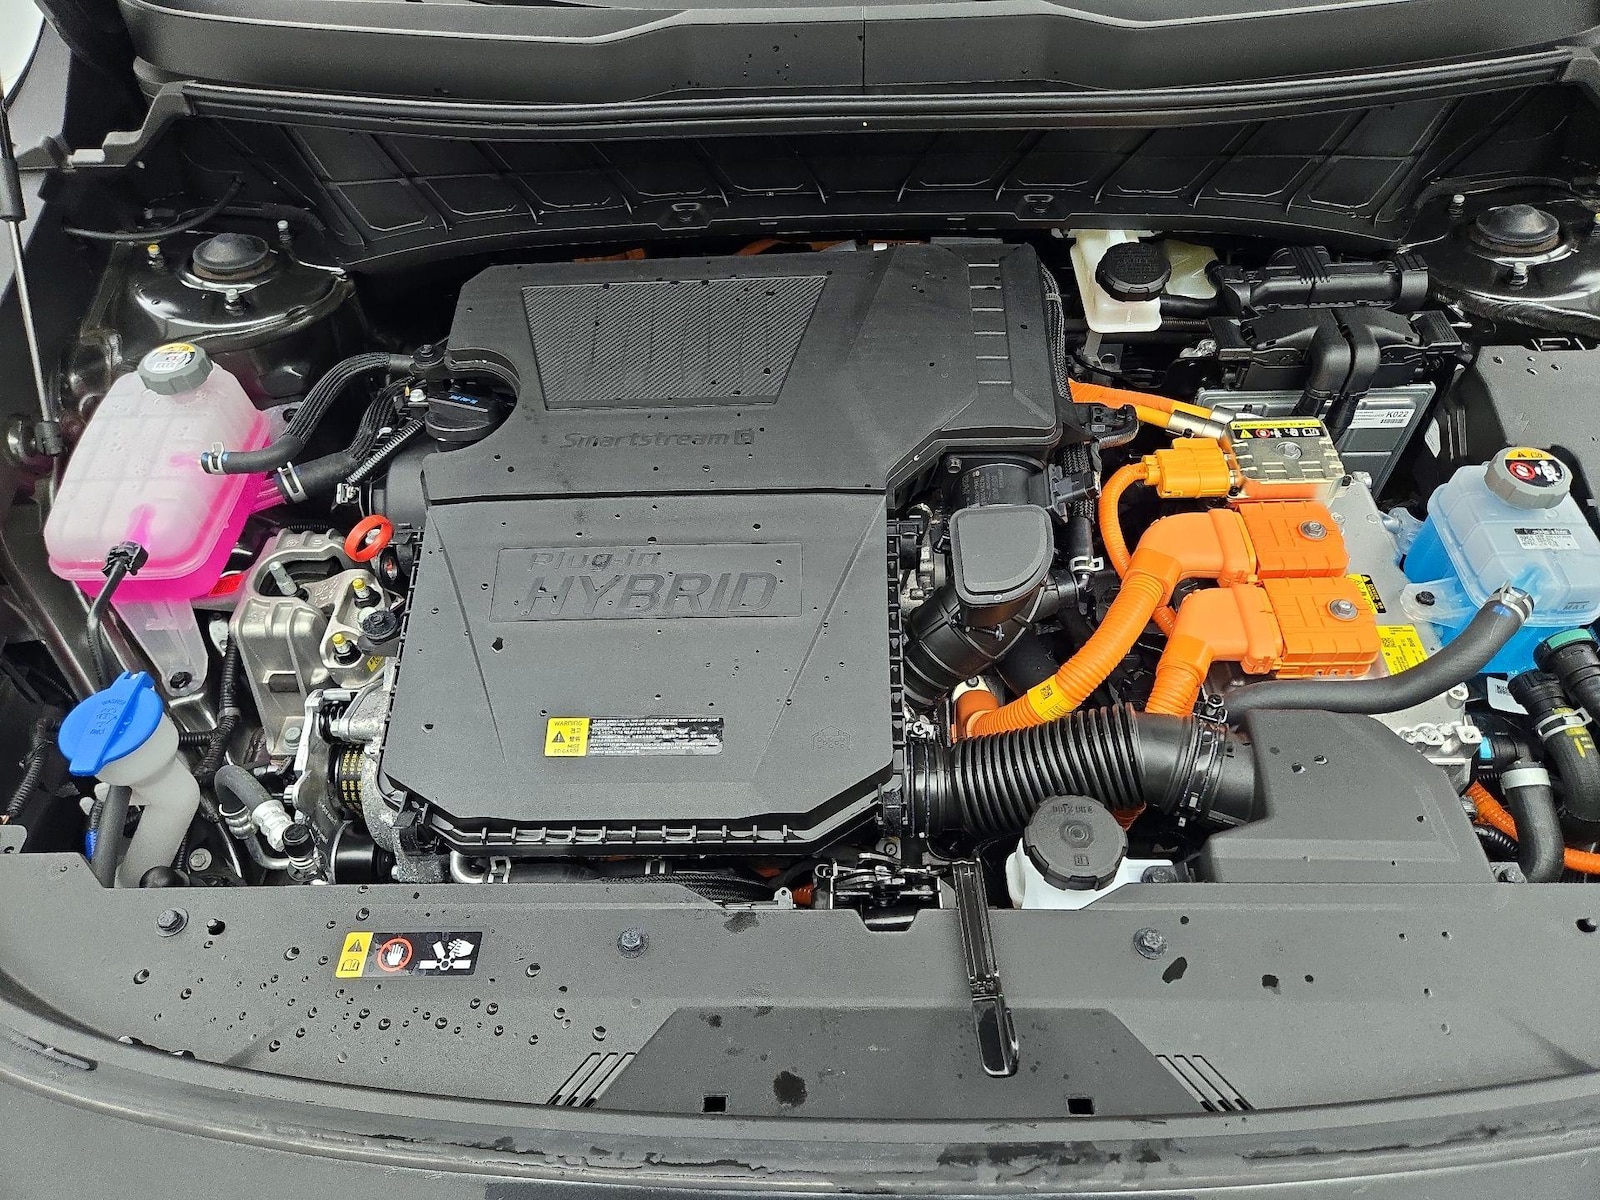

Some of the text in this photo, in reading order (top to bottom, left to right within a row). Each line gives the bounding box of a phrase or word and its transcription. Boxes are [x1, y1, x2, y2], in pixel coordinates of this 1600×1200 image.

[560, 432, 729, 448] Smartstream
[527, 548, 660, 573] Plug-in
[520, 573, 778, 616] HYBRID
